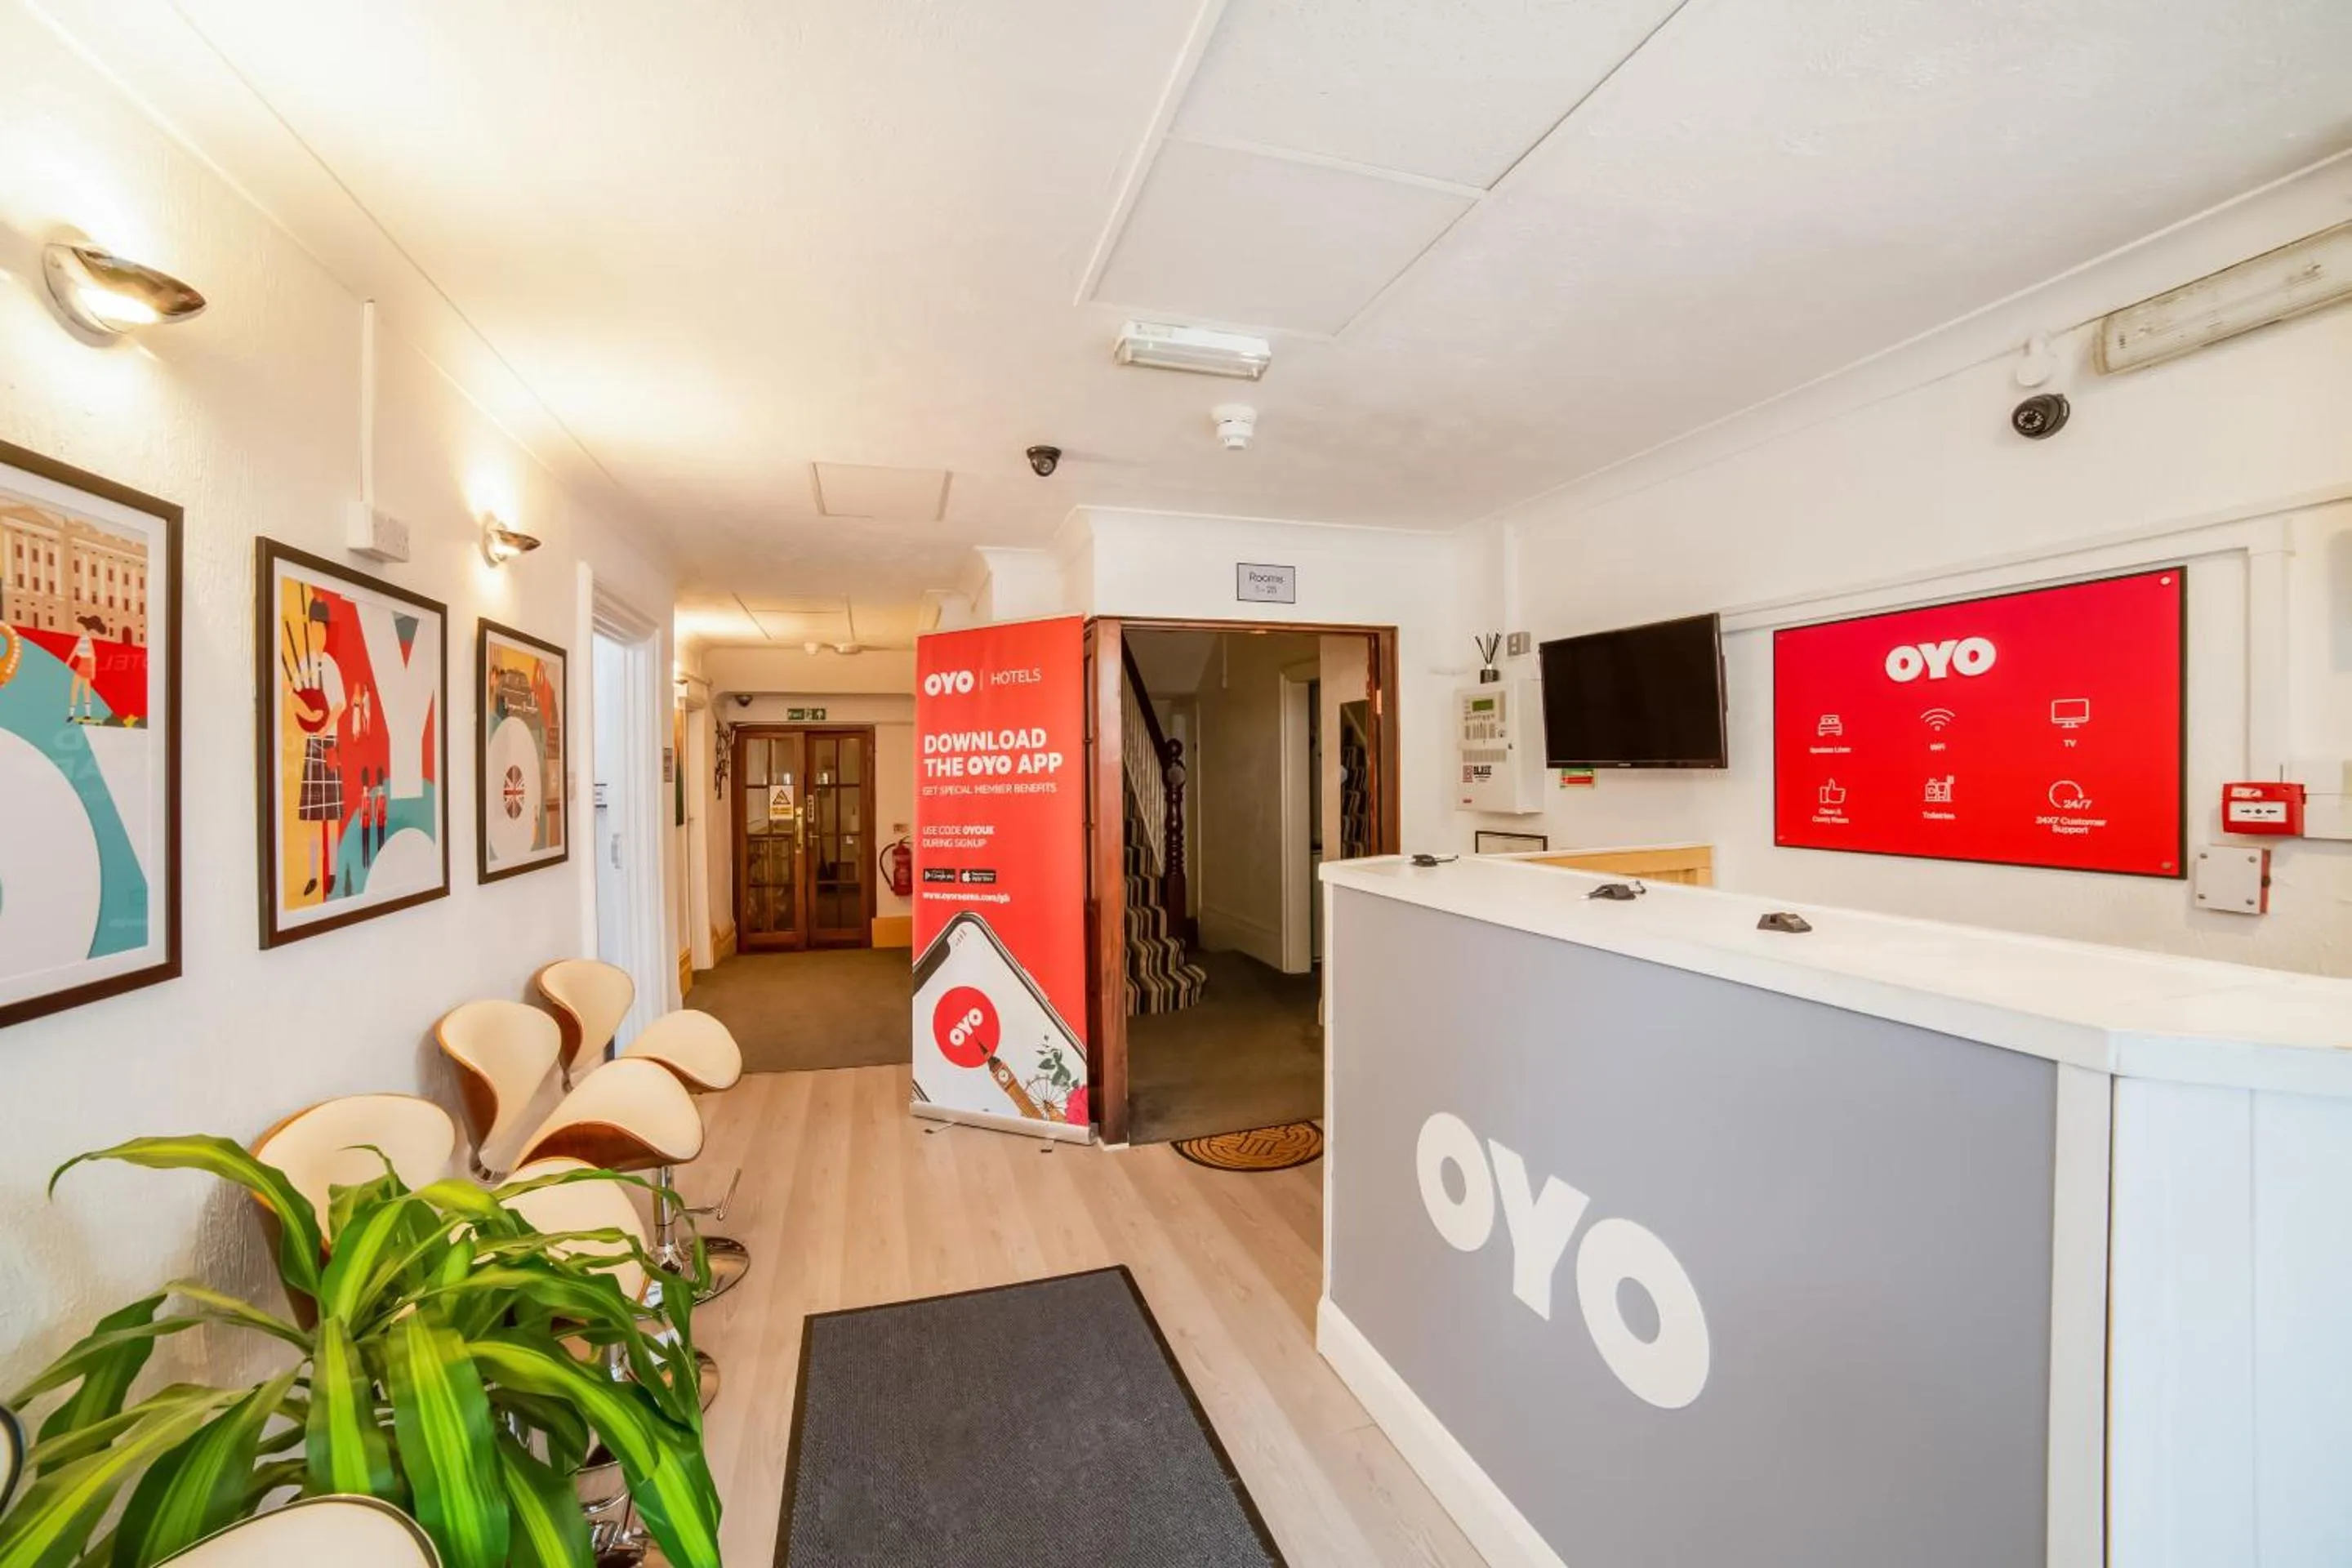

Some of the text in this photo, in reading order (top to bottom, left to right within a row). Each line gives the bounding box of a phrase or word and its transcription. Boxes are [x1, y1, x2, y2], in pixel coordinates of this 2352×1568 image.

[1249, 572, 1285, 583] Rooms
[1885, 637, 1997, 683] OYO
[924, 668, 1041, 696] OYO HOTELS
[924, 728, 1046, 754] DOWNLOAD
[2063, 739, 2077, 747] TV
[924, 752, 1063, 777] THE OYO APP
[923, 782, 1058, 796] GET SPECIAL MEMBER BENEFITS
[2063, 800, 2092, 809] 24/7
[2060, 817, 2107, 826] Customer
[923, 826, 938, 835] USE
[939, 826, 962, 835] CODE
[2051, 824, 2089, 835] Support
[923, 838, 953, 848] DURING
[949, 1008, 983, 1046] OYO
[1417, 1111, 1709, 1410] OYO
